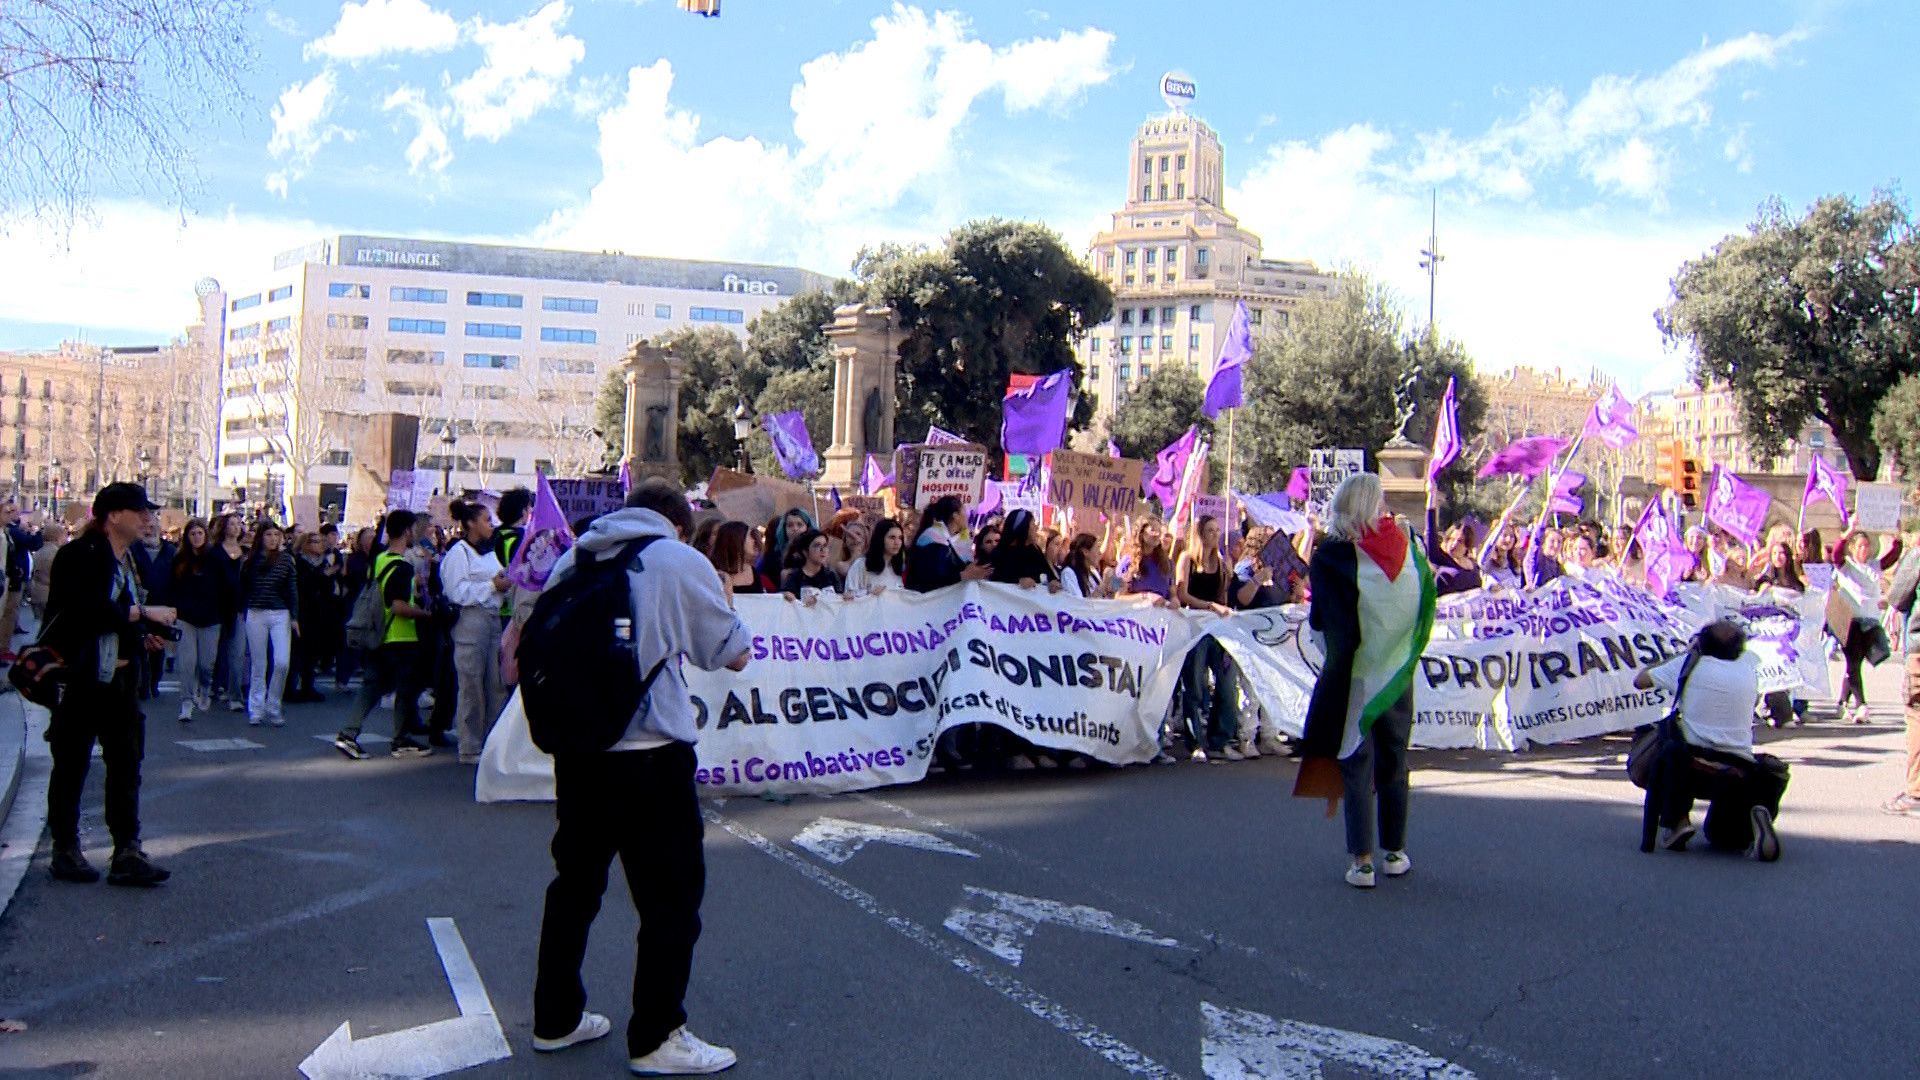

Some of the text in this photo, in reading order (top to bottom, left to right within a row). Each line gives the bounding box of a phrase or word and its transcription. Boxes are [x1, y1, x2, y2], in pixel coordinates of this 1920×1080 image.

[1166, 81, 1194, 94] BBVA
[357, 249, 440, 266] EL TRIANGLE
[723, 273, 778, 294] fnac
[1083, 483, 1135, 513] VALENTA
[751, 636, 769, 660] S
[990, 612, 1052, 634] AMB
[717, 687, 778, 730] AL
[779, 647, 961, 724] GENOCIDI
[967, 638, 1142, 699] SIONISTA!
[1420, 651, 1521, 690] PROU
[1575, 690, 1664, 718] COMBATIVES
[744, 747, 905, 782] Combatives
[995, 697, 1120, 746] d'Estudiants
